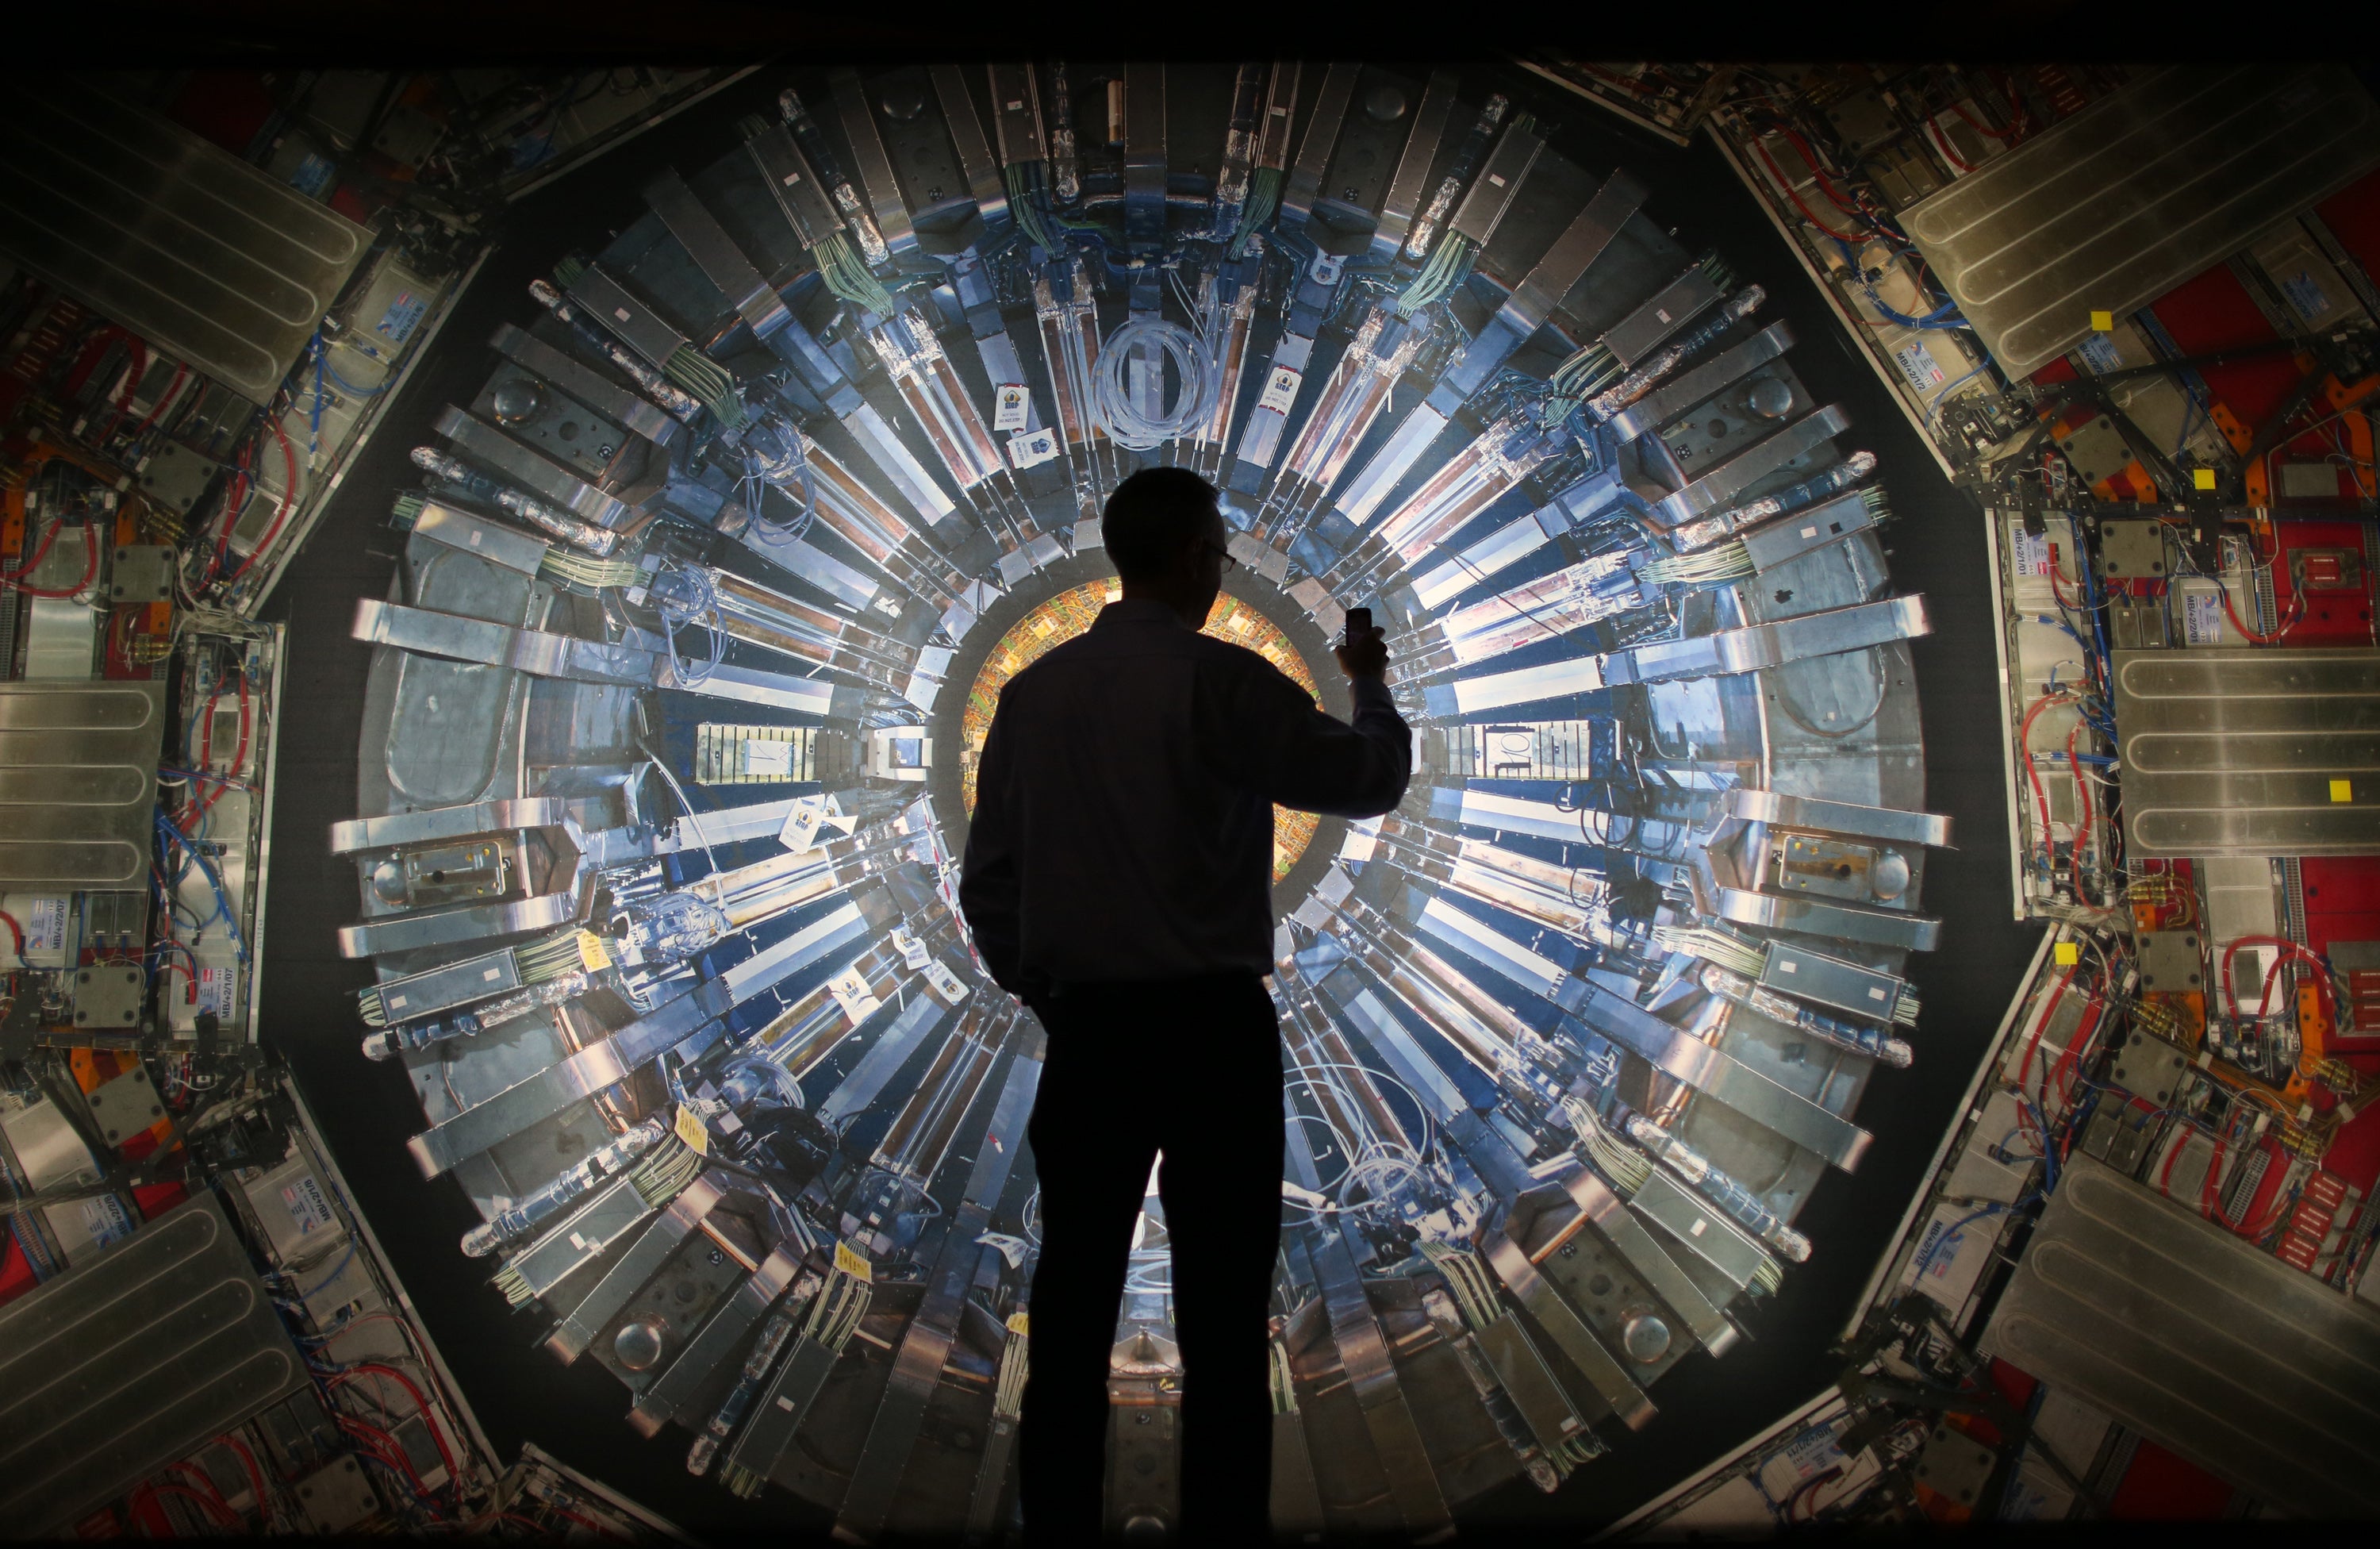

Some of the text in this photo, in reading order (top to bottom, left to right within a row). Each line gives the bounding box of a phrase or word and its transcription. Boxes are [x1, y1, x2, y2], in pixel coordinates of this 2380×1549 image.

[395, 304, 424, 343] MB/+2/1/6
[1274, 382, 1290, 393] STOP
[1895, 352, 1925, 390] MB/+2/1/2
[1030, 440, 1040, 455] STOP
[2014, 529, 2026, 575] MB/+2/1/01
[2186, 595, 2198, 642] MB/+2/2/01
[793, 818, 809, 831] STOP
[52, 899, 65, 949] MB/+2/2/07
[221, 968, 232, 1017] MB/+2/1/07
[845, 986, 860, 999] STOP
[303, 1178, 331, 1221] MB/+2/1/8
[1914, 1220, 1942, 1266] MB/+2/1/12
[1786, 1424, 1833, 1459] MB/+2/1/11
